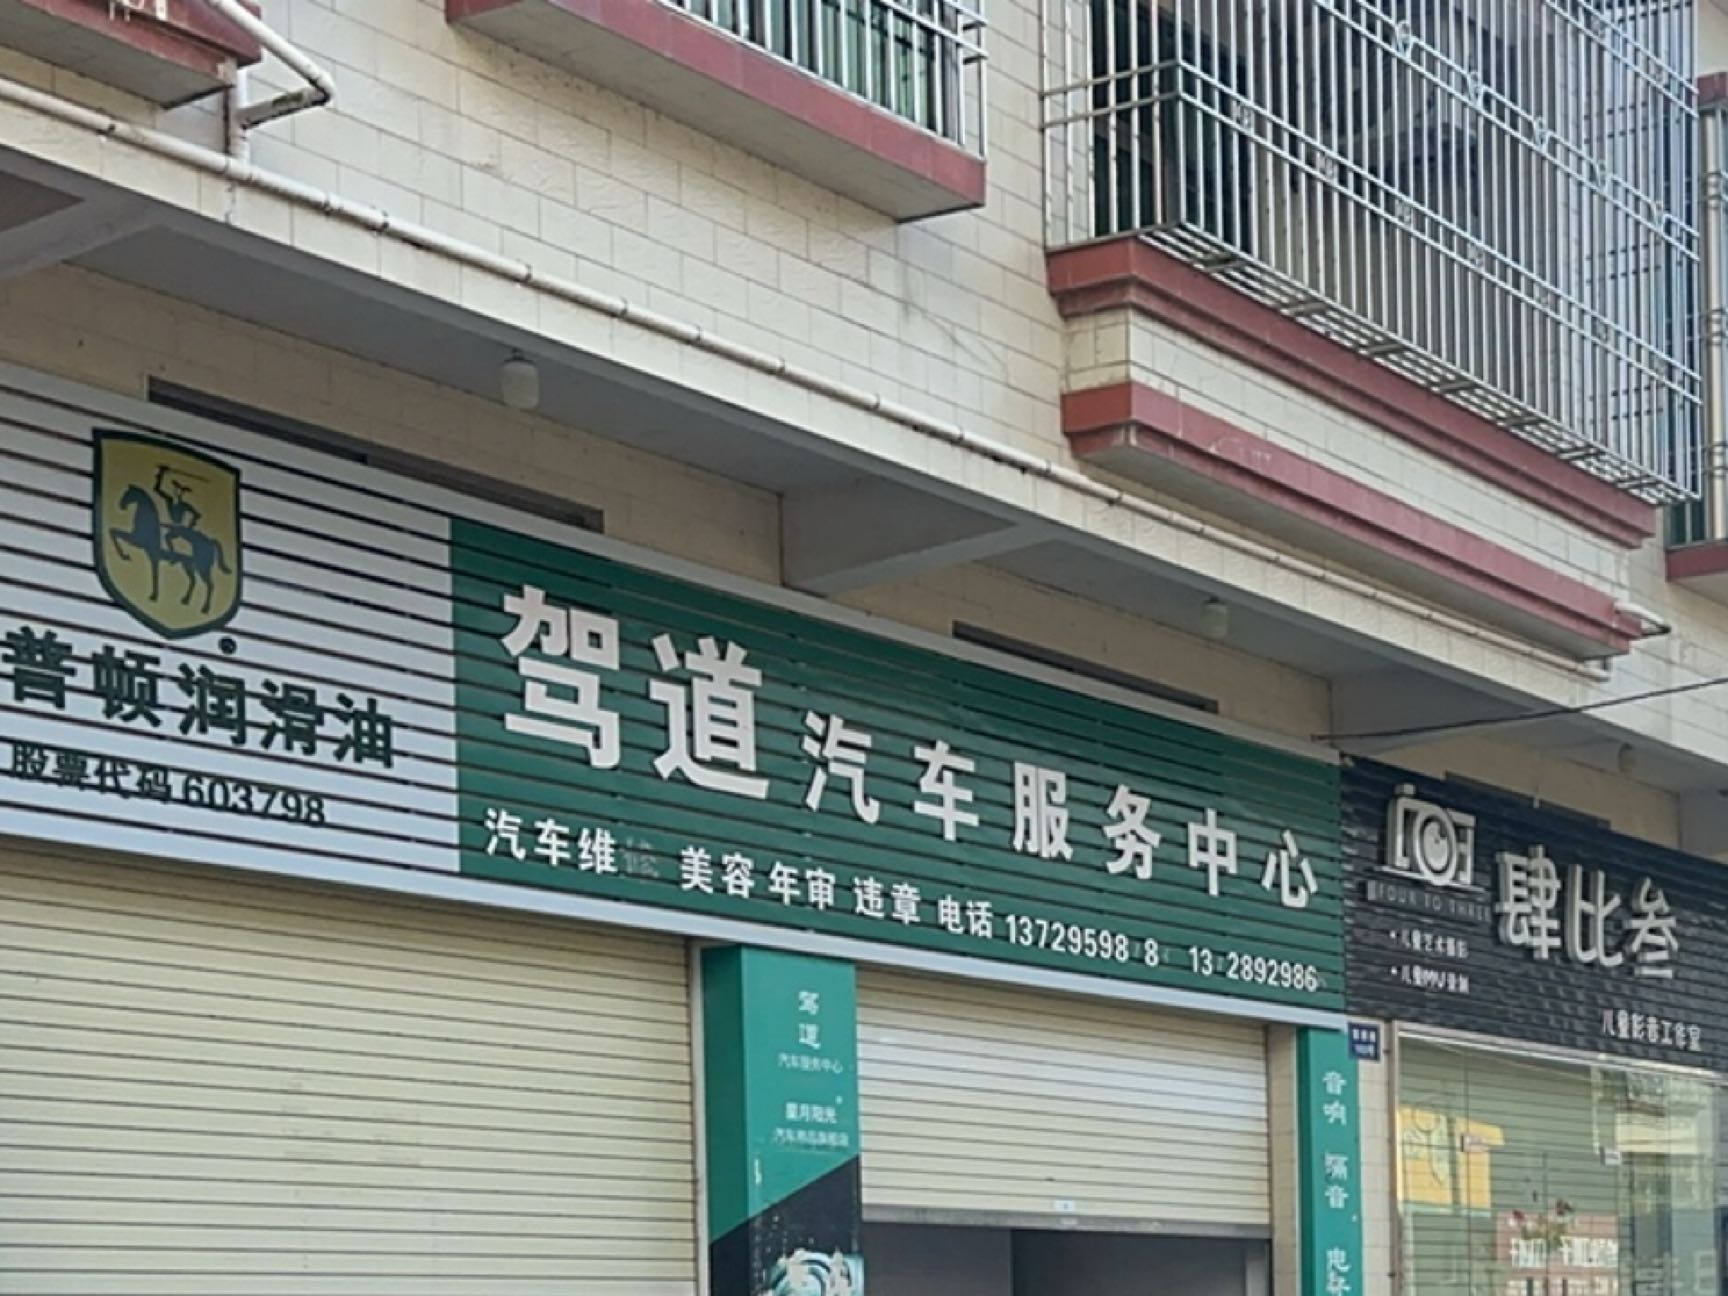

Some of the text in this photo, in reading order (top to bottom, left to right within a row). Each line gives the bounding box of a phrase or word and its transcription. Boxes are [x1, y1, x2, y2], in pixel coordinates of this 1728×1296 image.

[2, 626, 394, 769] 普顿润滑油
[502, 583, 1319, 910] 驾道 汽车服务中心
[12, 741, 326, 827] 股票代码603798
[938, 894, 993, 939] 电话
[1005, 914, 1170, 968] 137295988
[1188, 945, 1327, 992] 132892986
[1496, 845, 1678, 980] 肆比叁
